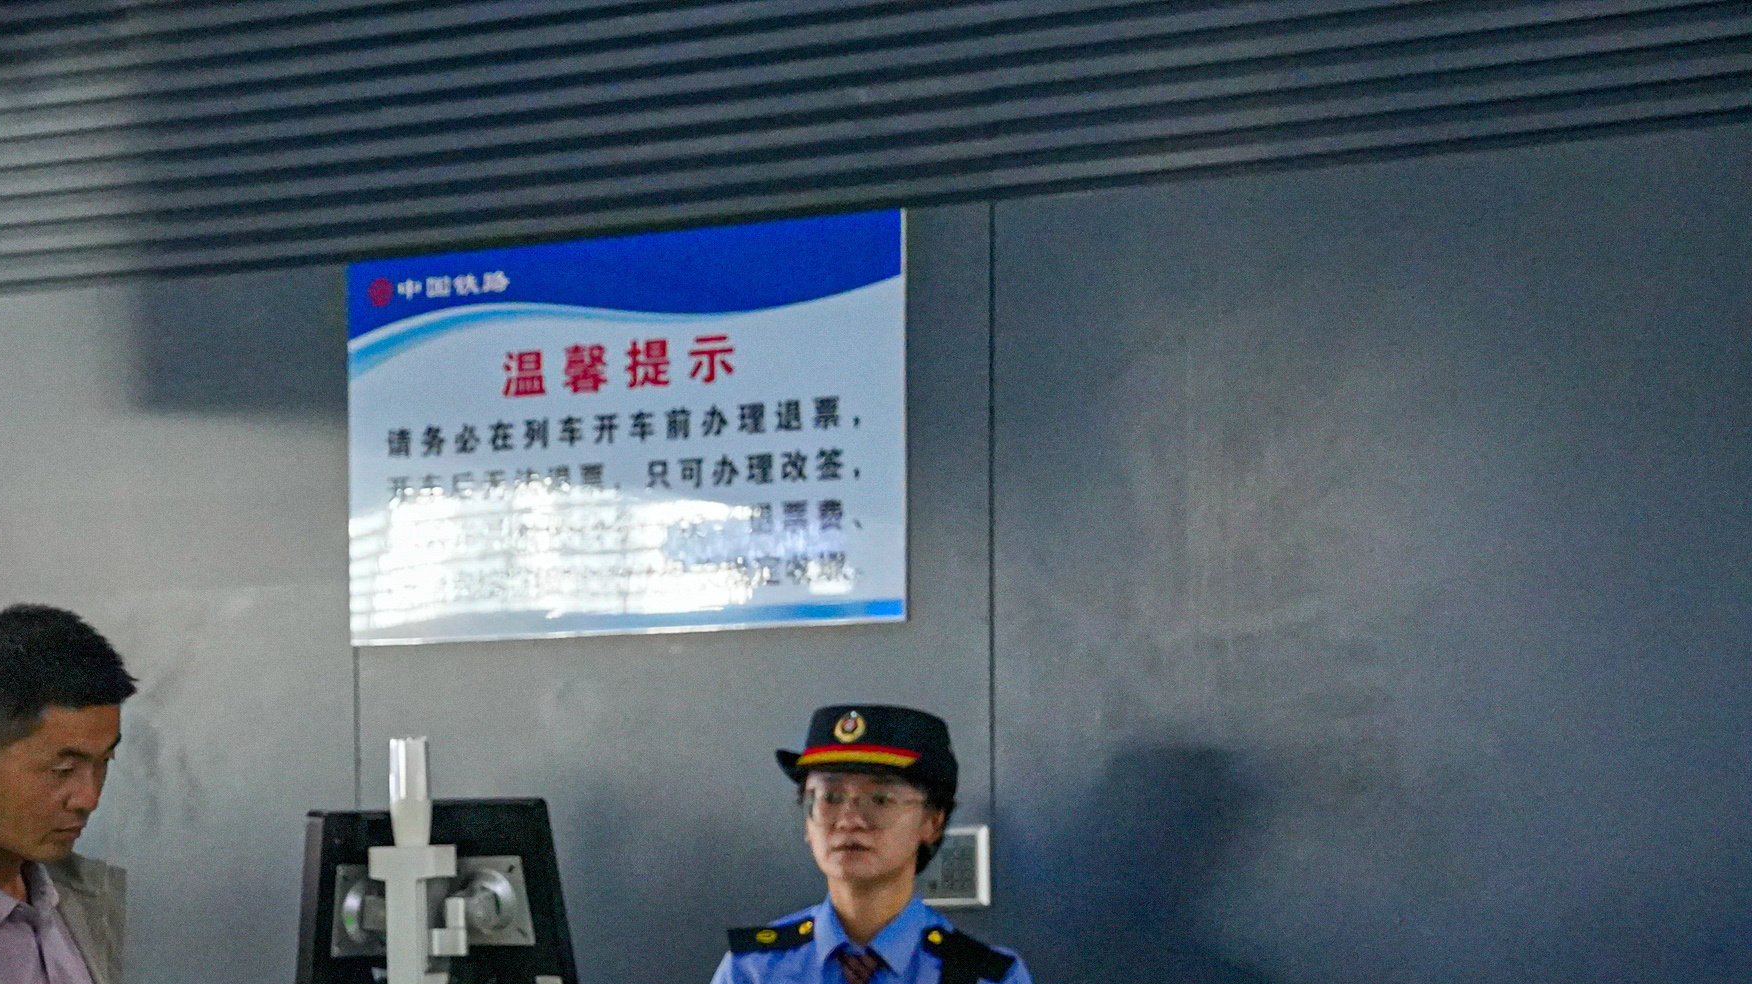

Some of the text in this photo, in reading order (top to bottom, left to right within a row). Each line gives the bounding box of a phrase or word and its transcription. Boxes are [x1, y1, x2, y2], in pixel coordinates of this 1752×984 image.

[502, 334, 736, 397] 温馨提示
[386, 396, 863, 458] 请务必在列车开车前办理退票，
